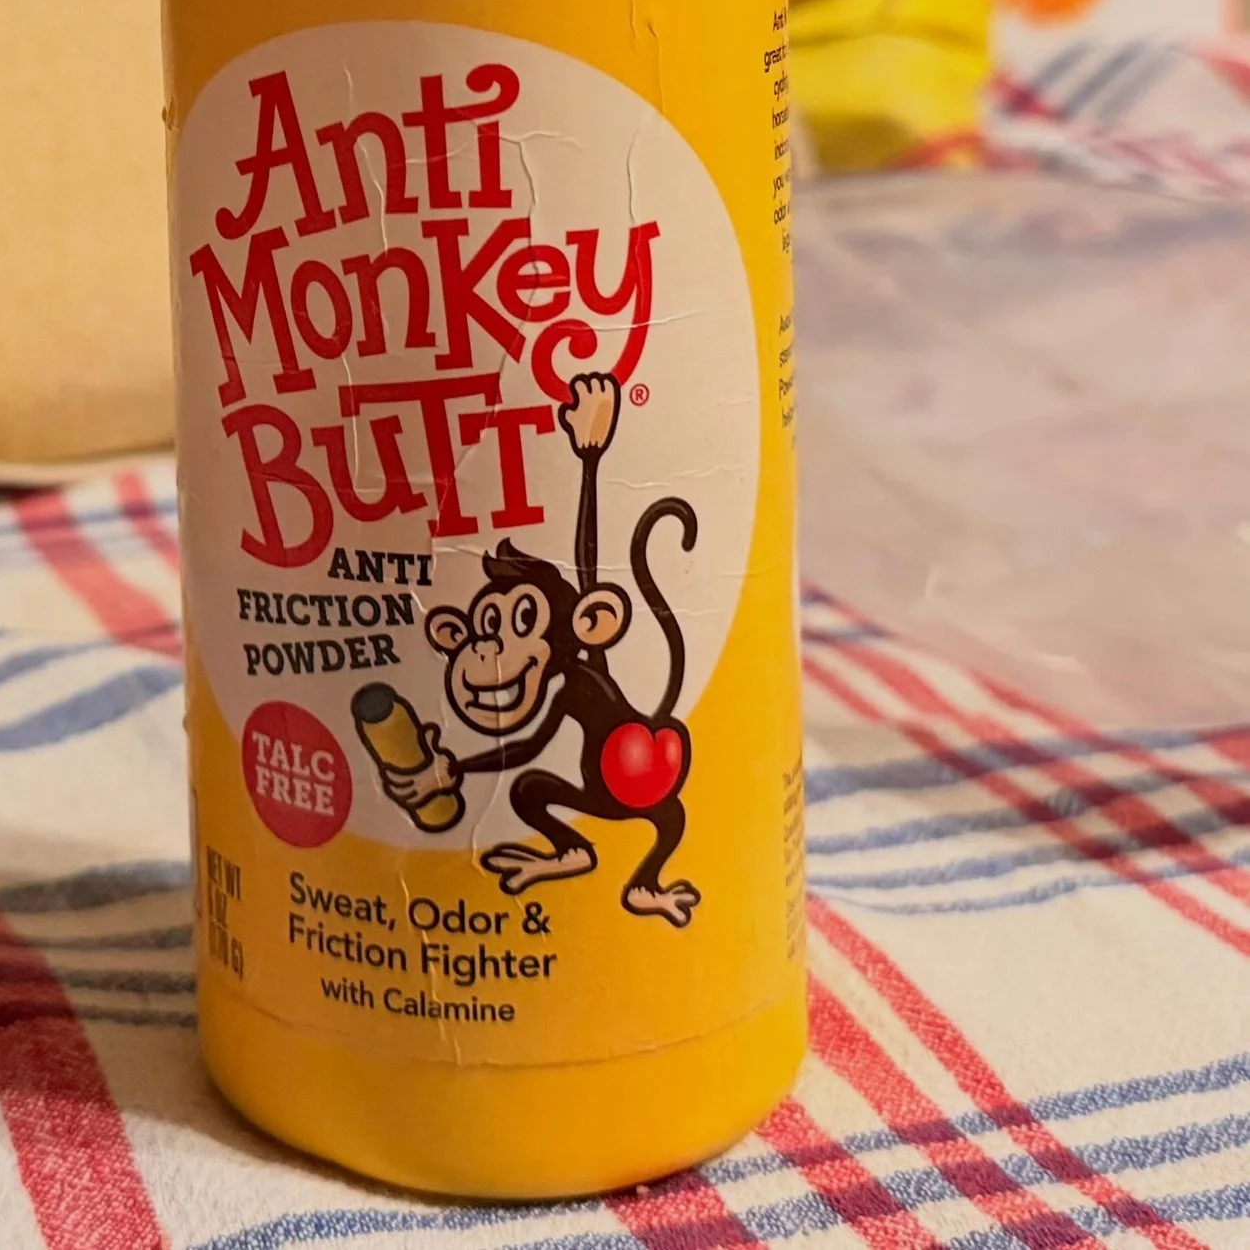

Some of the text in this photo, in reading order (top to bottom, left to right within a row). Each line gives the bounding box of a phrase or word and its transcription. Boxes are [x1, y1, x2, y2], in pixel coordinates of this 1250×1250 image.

[215, 63, 520, 239] Anti
[327, 547, 434, 587] ANTI
[236, 588, 416, 629] FRICTION
[243, 633, 402, 677] POWDER
[251, 730, 336, 782] TALC
[254, 770, 335, 817] FREE
[289, 871, 551, 937] Sweat, Odor &
[288, 913, 408, 972] Friction
[421, 943, 558, 987] Fighter
[320, 974, 516, 1025] with Calamine
